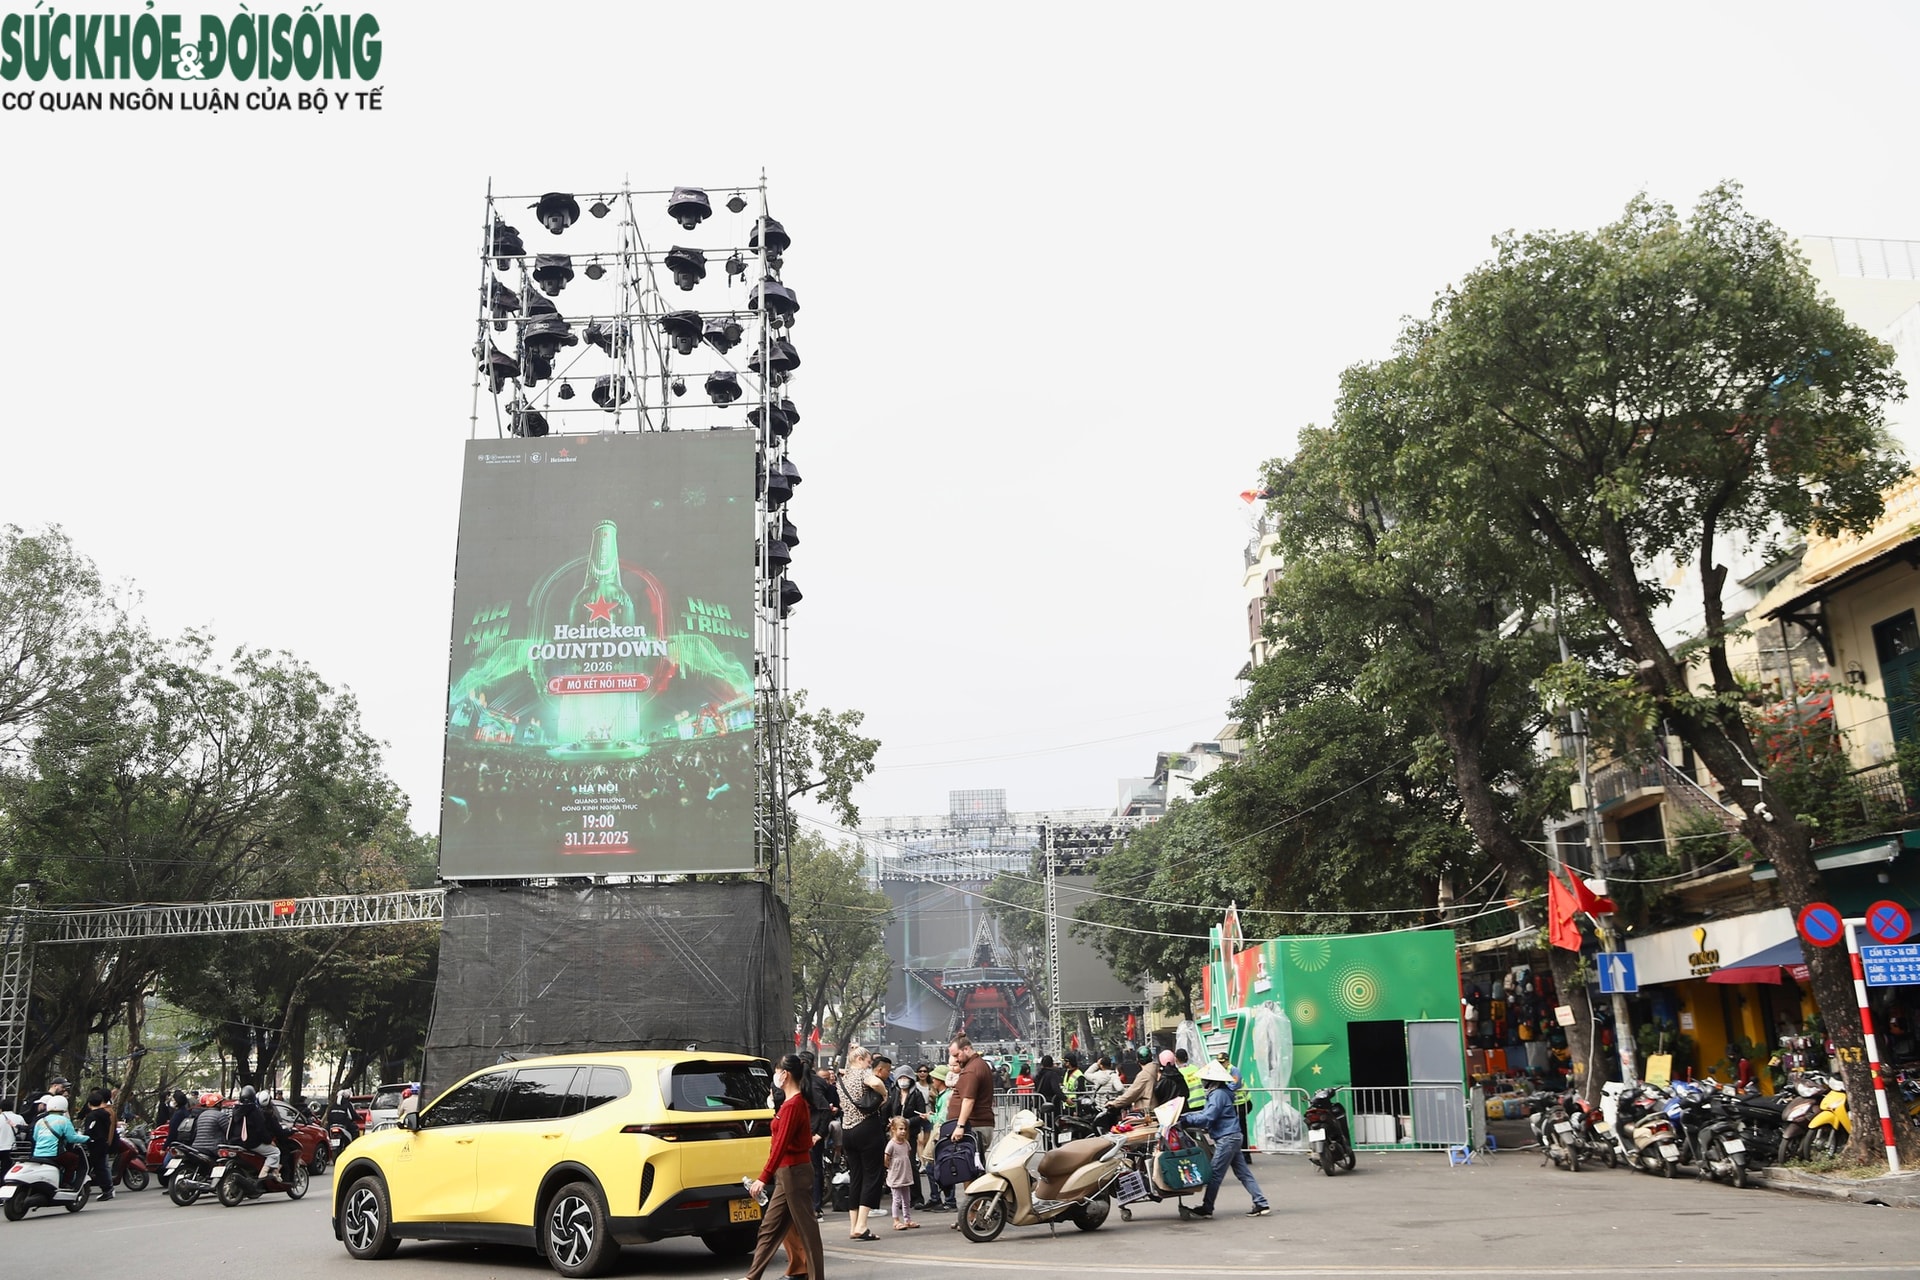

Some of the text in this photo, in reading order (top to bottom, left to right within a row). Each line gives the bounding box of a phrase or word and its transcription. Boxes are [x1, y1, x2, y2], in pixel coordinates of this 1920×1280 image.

[553, 623, 647, 640] Heineken
[528, 640, 668, 660] COUNTDOWN
[583, 662, 613, 672] 2026
[578, 782, 595, 793] HÀ
[582, 814, 615, 828] 19:00
[564, 831, 629, 846] 31.12.2025
